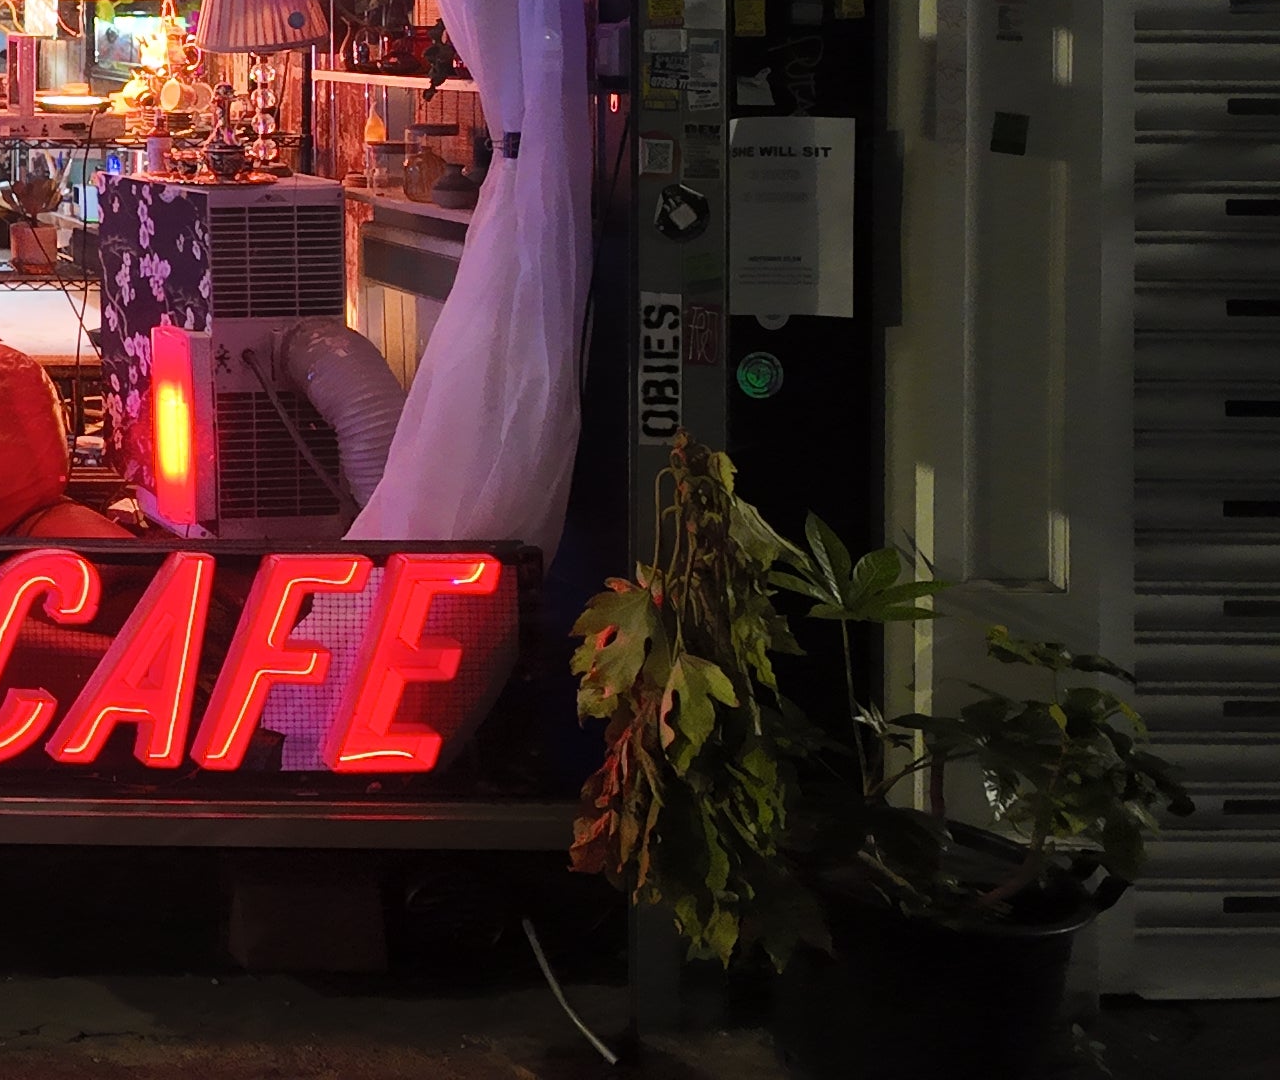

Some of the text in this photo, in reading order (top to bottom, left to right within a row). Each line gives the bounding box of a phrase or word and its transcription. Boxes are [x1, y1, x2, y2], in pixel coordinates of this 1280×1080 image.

[731, 146, 832, 158] SHE WILL SIT
[641, 304, 680, 438] OBIES
